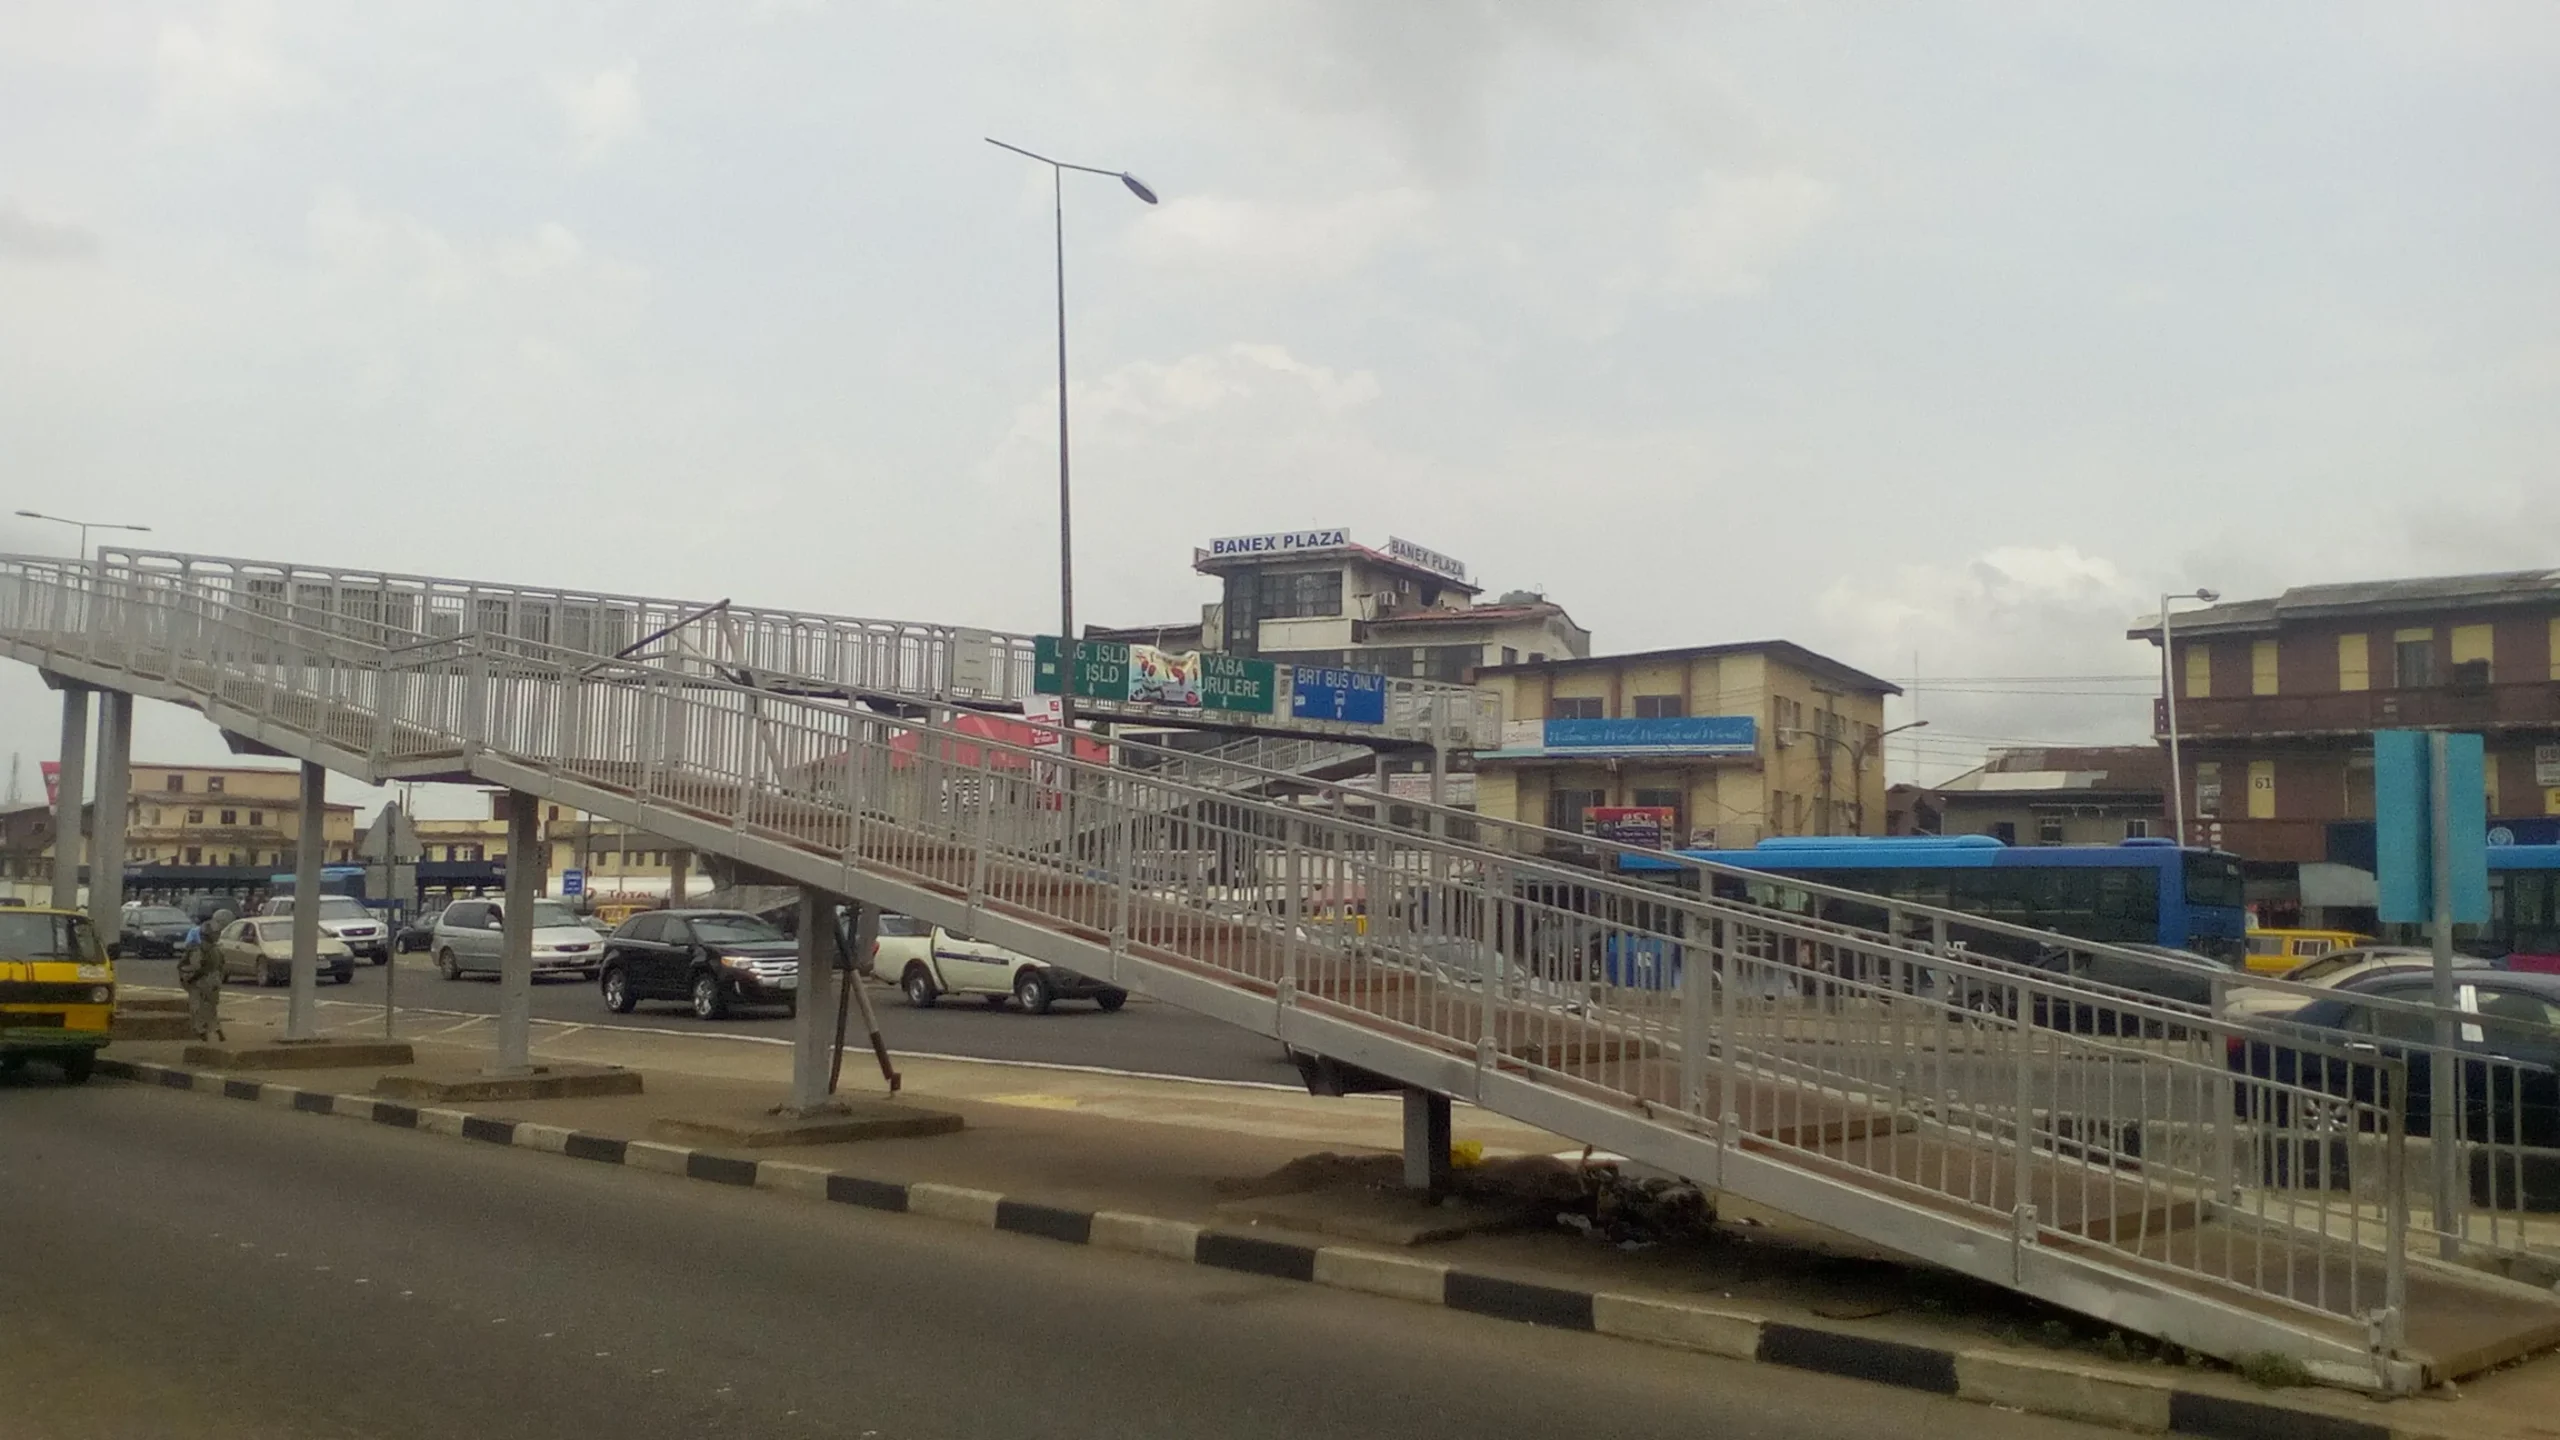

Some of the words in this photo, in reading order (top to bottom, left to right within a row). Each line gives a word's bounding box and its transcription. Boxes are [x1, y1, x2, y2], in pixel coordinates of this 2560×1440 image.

[1213, 536, 1276, 554] BANEX
[1283, 531, 1345, 549] PLAZA
[1391, 539, 1428, 566] BANEX
[1432, 554, 1465, 578] PLAZA
[1054, 639, 1090, 661] LG.
[1096, 643, 1129, 665] ISLD
[1086, 663, 1119, 683] ISLD
[1207, 656, 1246, 678] YABA
[1201, 675, 1261, 698] URULERE
[1297, 667, 1322, 686] BRT
[1325, 670, 1349, 689] BUS
[1352, 673, 1382, 693] ONLY
[607, 889, 657, 900] TOTAL
